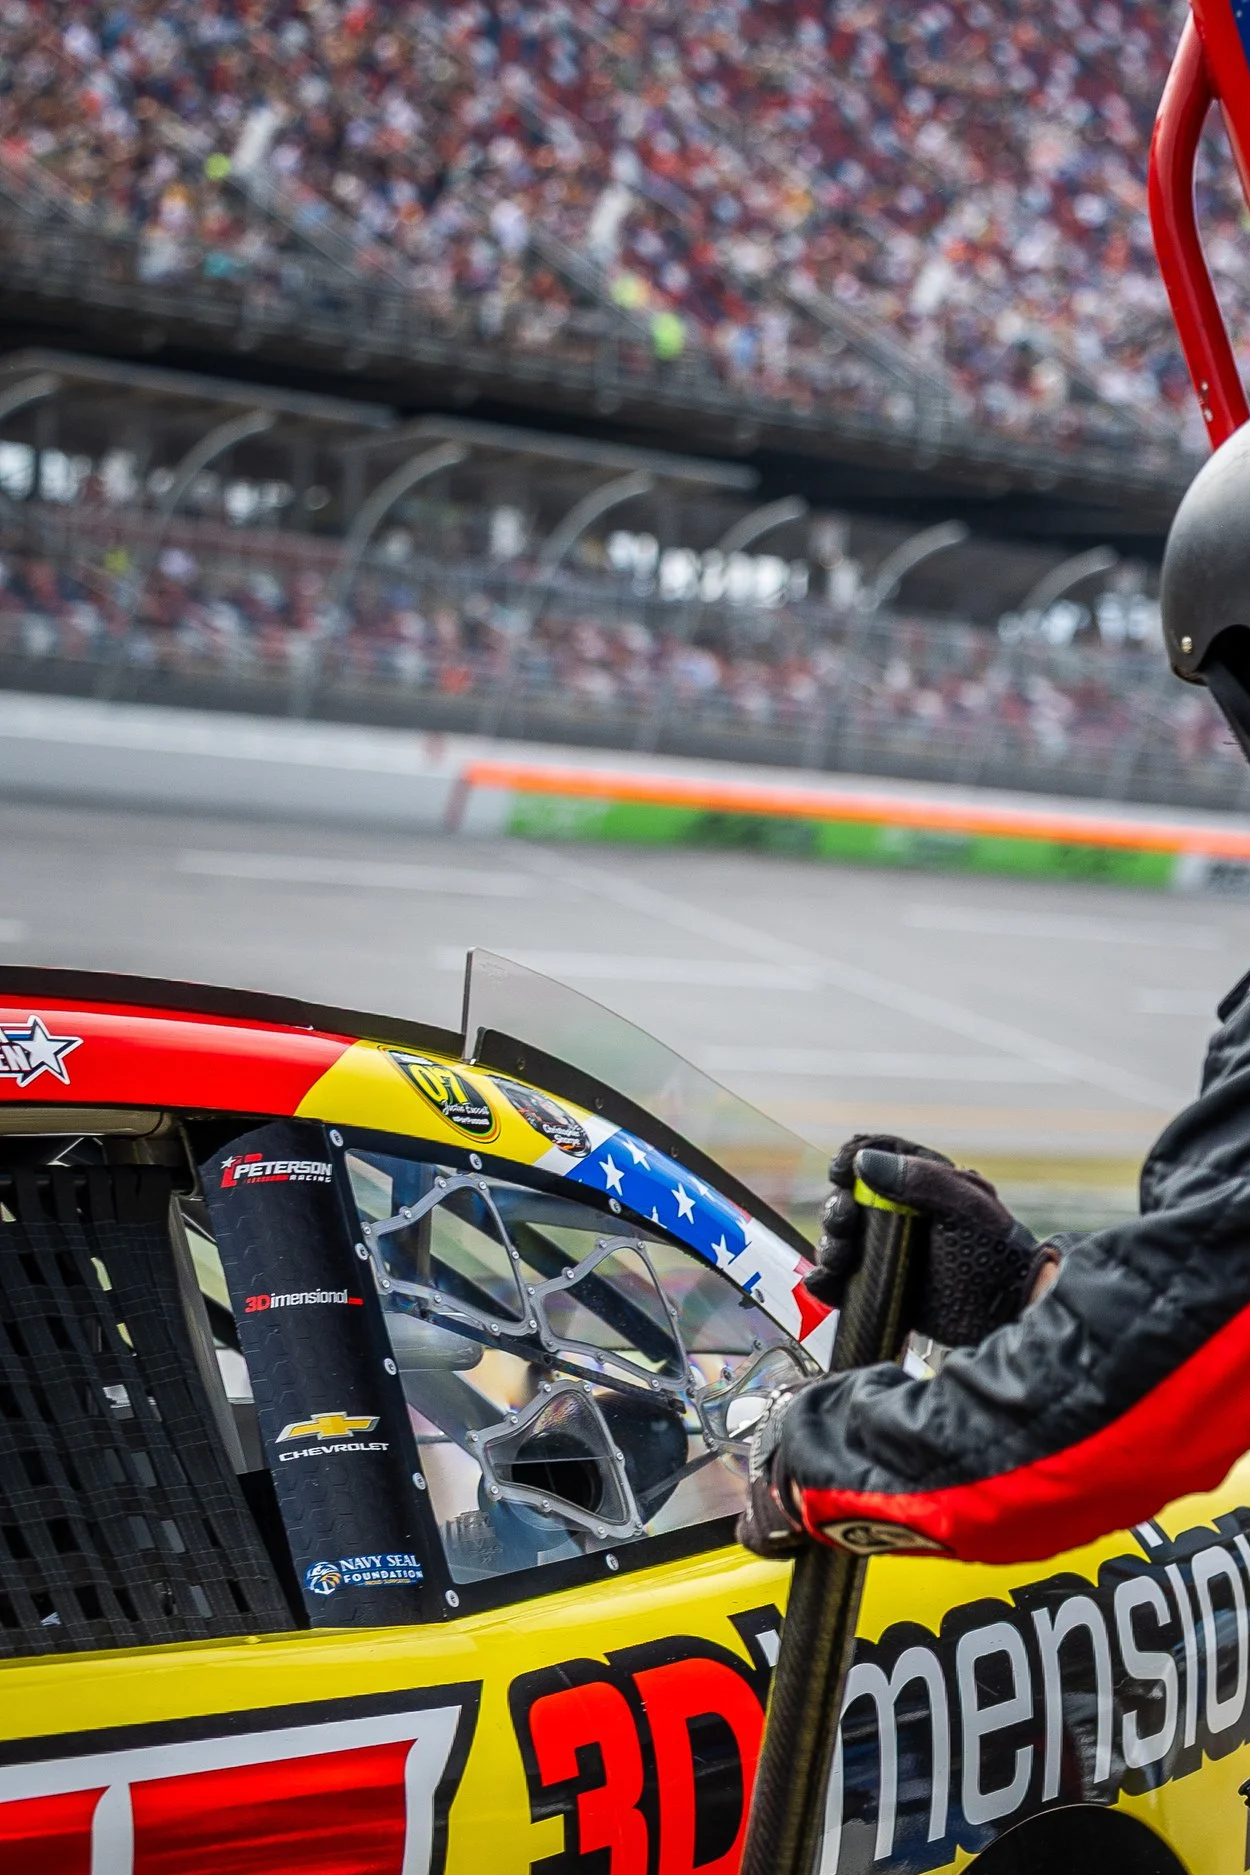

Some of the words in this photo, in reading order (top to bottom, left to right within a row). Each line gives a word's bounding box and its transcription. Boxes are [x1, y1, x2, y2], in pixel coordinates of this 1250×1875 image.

[408, 1062, 468, 1104] 07
[233, 1160, 333, 1180] PETERSON
[289, 1174, 332, 1183] RACING
[244, 1288, 349, 1313] 3Dimensional
[279, 1442, 390, 1462] CHEVROLET
[339, 1555, 384, 1572] NAVY
[386, 1553, 422, 1568] SEAL
[344, 1569, 424, 1583] FOUNDATION
